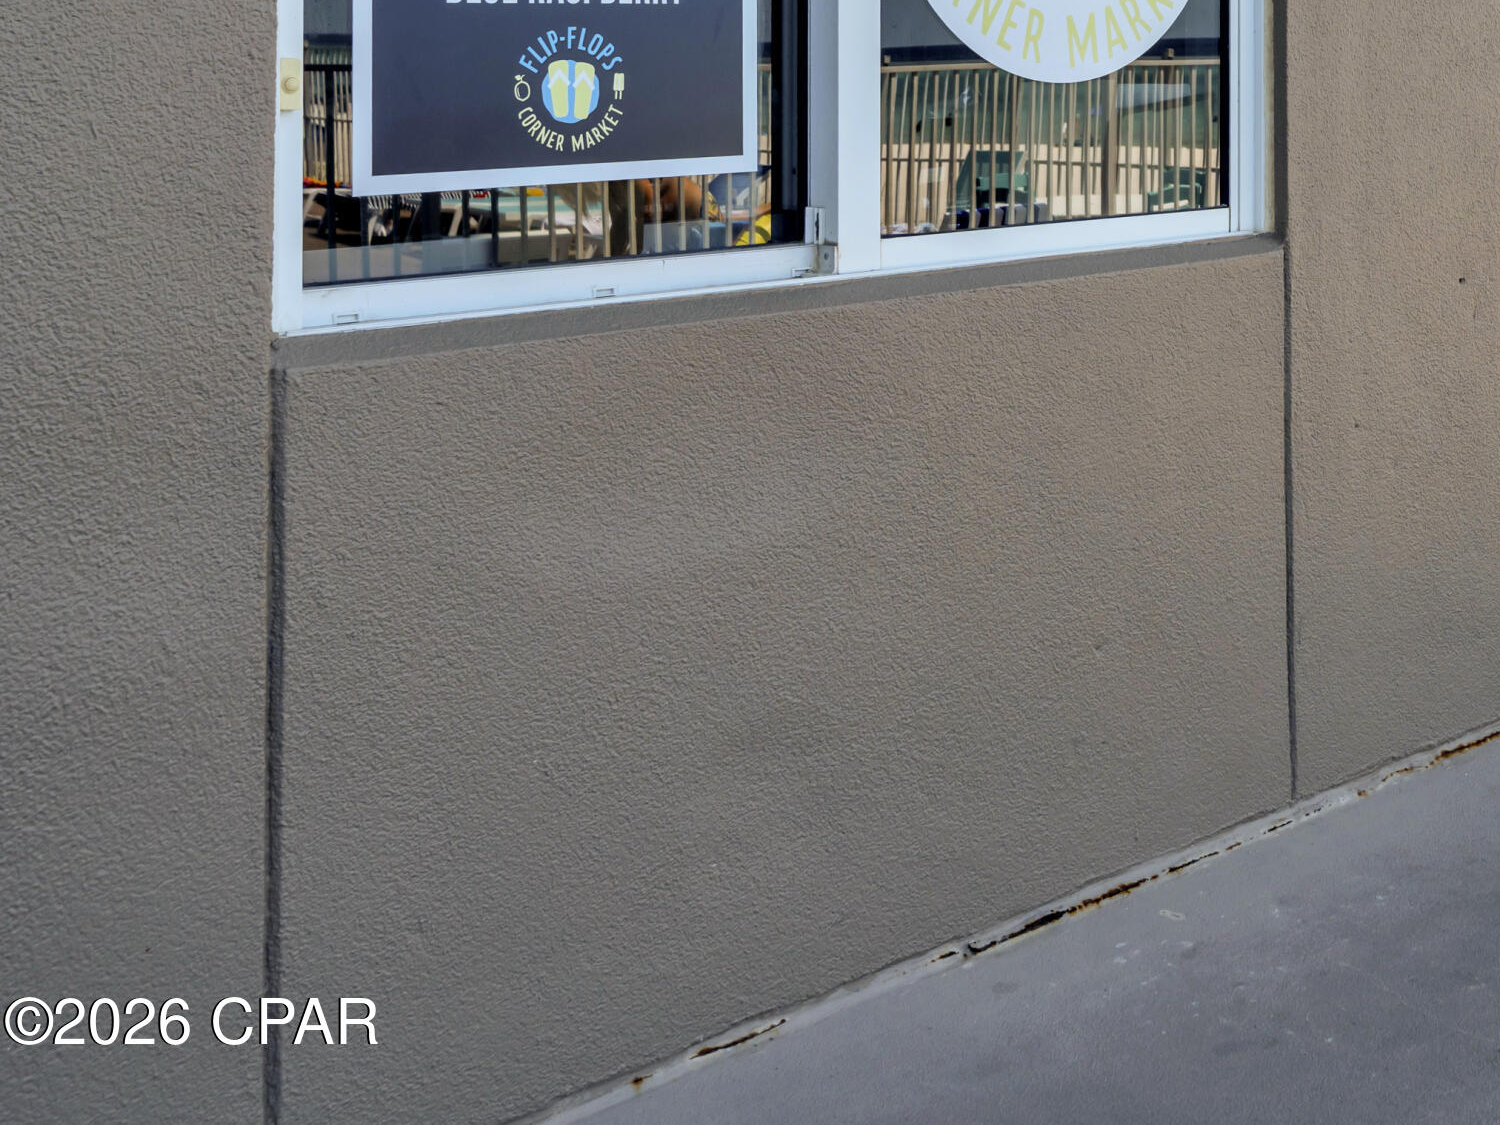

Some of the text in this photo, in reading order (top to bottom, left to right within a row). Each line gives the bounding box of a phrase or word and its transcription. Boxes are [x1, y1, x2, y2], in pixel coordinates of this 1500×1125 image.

[519, 26, 623, 73] FLIP-FLOPS
[517, 104, 625, 152] CORNER MARKET
